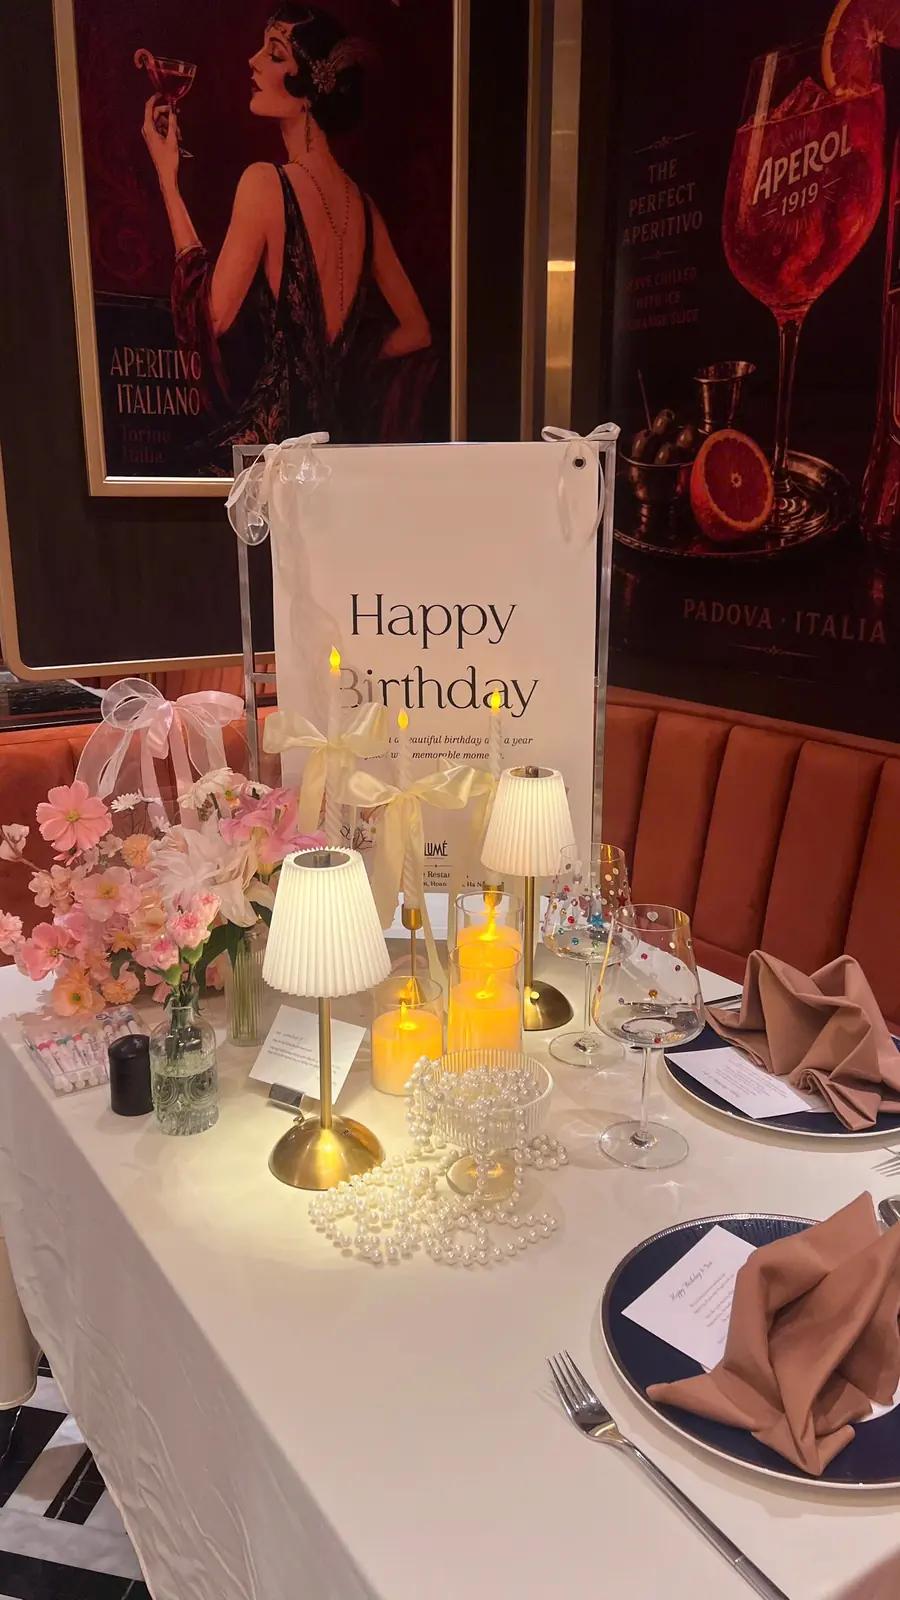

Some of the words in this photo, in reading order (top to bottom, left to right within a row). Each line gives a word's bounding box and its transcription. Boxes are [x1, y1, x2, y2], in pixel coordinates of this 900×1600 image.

[648, 158, 677, 184] THE
[752, 124, 852, 205] APEROL
[628, 182, 696, 218] PERFECT
[780, 182, 819, 216] 1919
[622, 210, 703, 246] APERITIVO
[110, 346, 201, 380] APERITIVO
[117, 383, 200, 416] ITALIANO
[350, 593, 517, 649] Happy
[682, 598, 773, 630] PADOVA
[795, 610, 887, 644] ITALIA
[339, 665, 540, 718] Birthday
[409, 735, 442, 746] eautiful
[444, 735, 483, 746] birthday
[511, 737, 534, 747] year
[412, 751, 461, 759] memorable
[424, 840, 449, 857] LUMÉ
